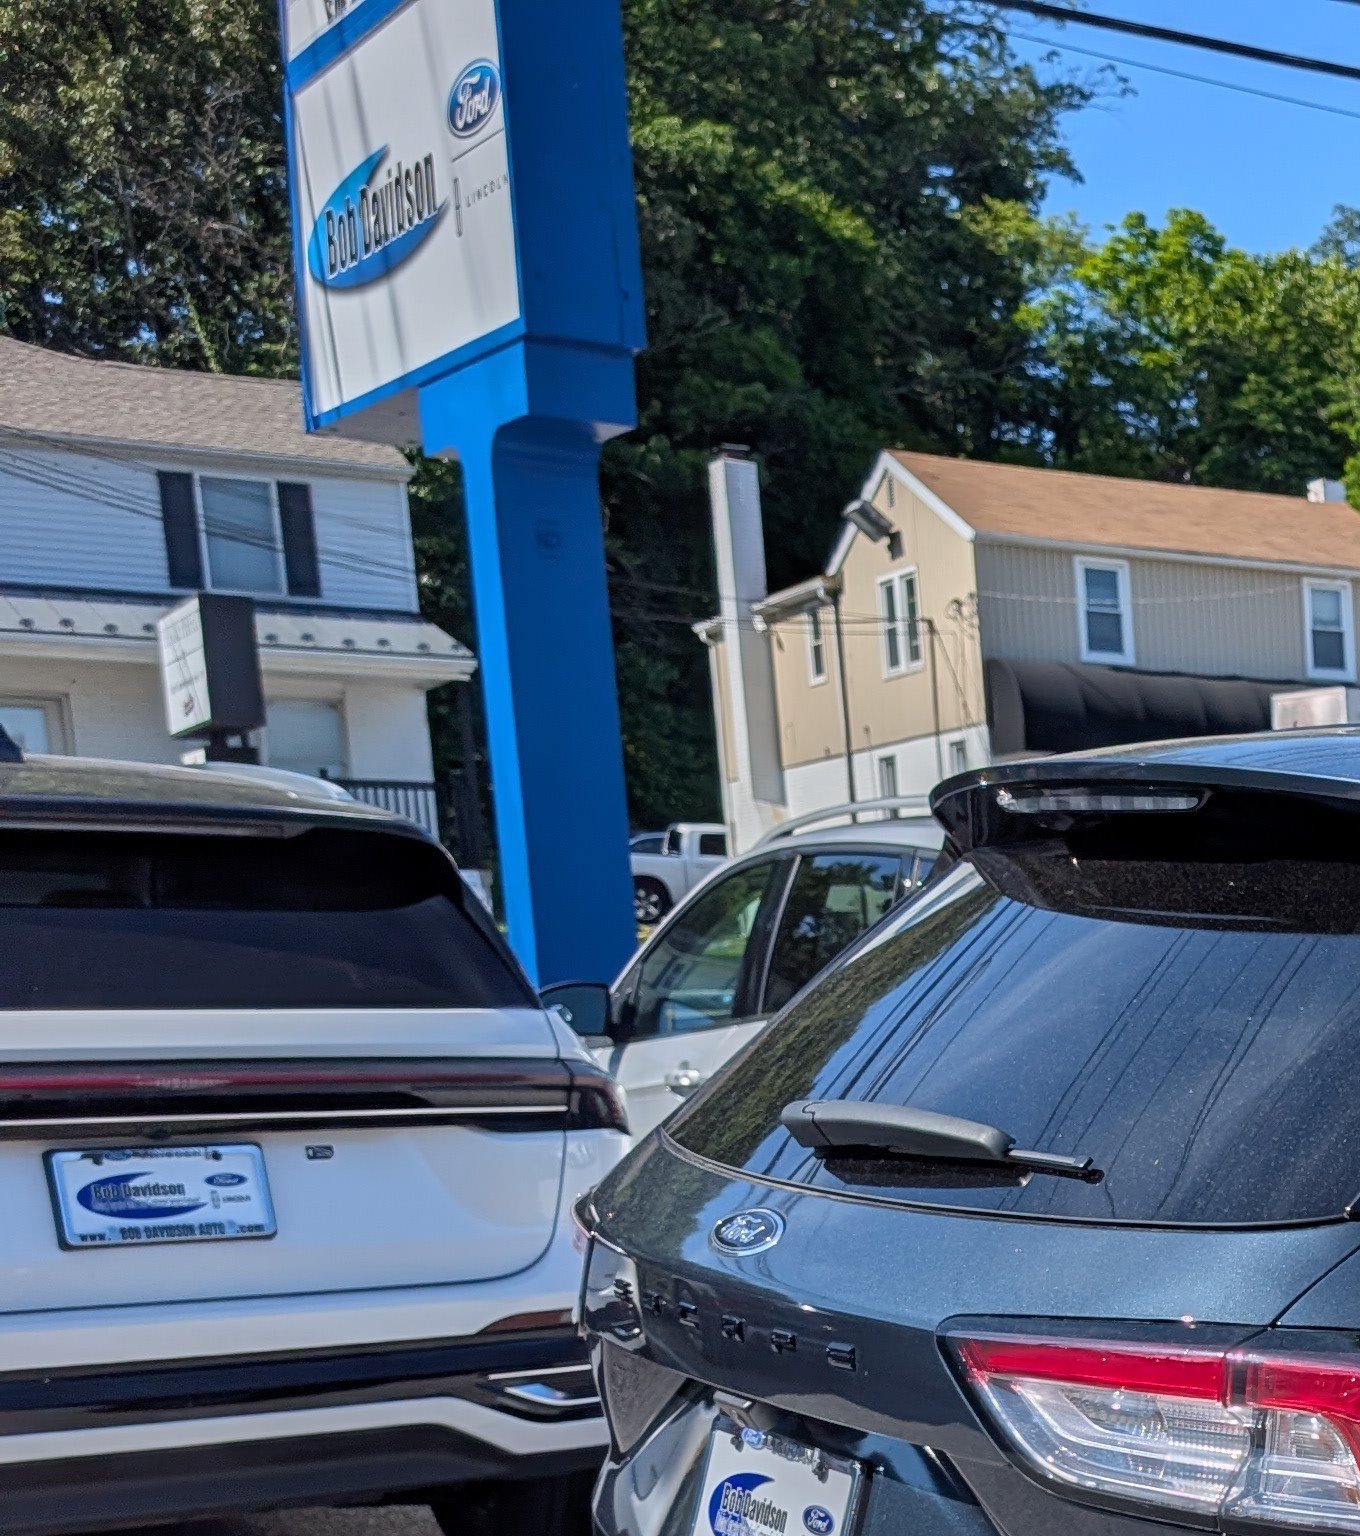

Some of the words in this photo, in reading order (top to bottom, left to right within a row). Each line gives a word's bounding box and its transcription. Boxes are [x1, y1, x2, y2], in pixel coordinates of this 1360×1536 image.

[456, 71, 493, 130] Ford
[325, 196, 359, 276] Bob
[360, 152, 438, 256] Davidson
[122, 1181, 186, 1198] Davidson
[722, 1483, 744, 1516] Bob
[743, 1488, 789, 1534] Davidson
